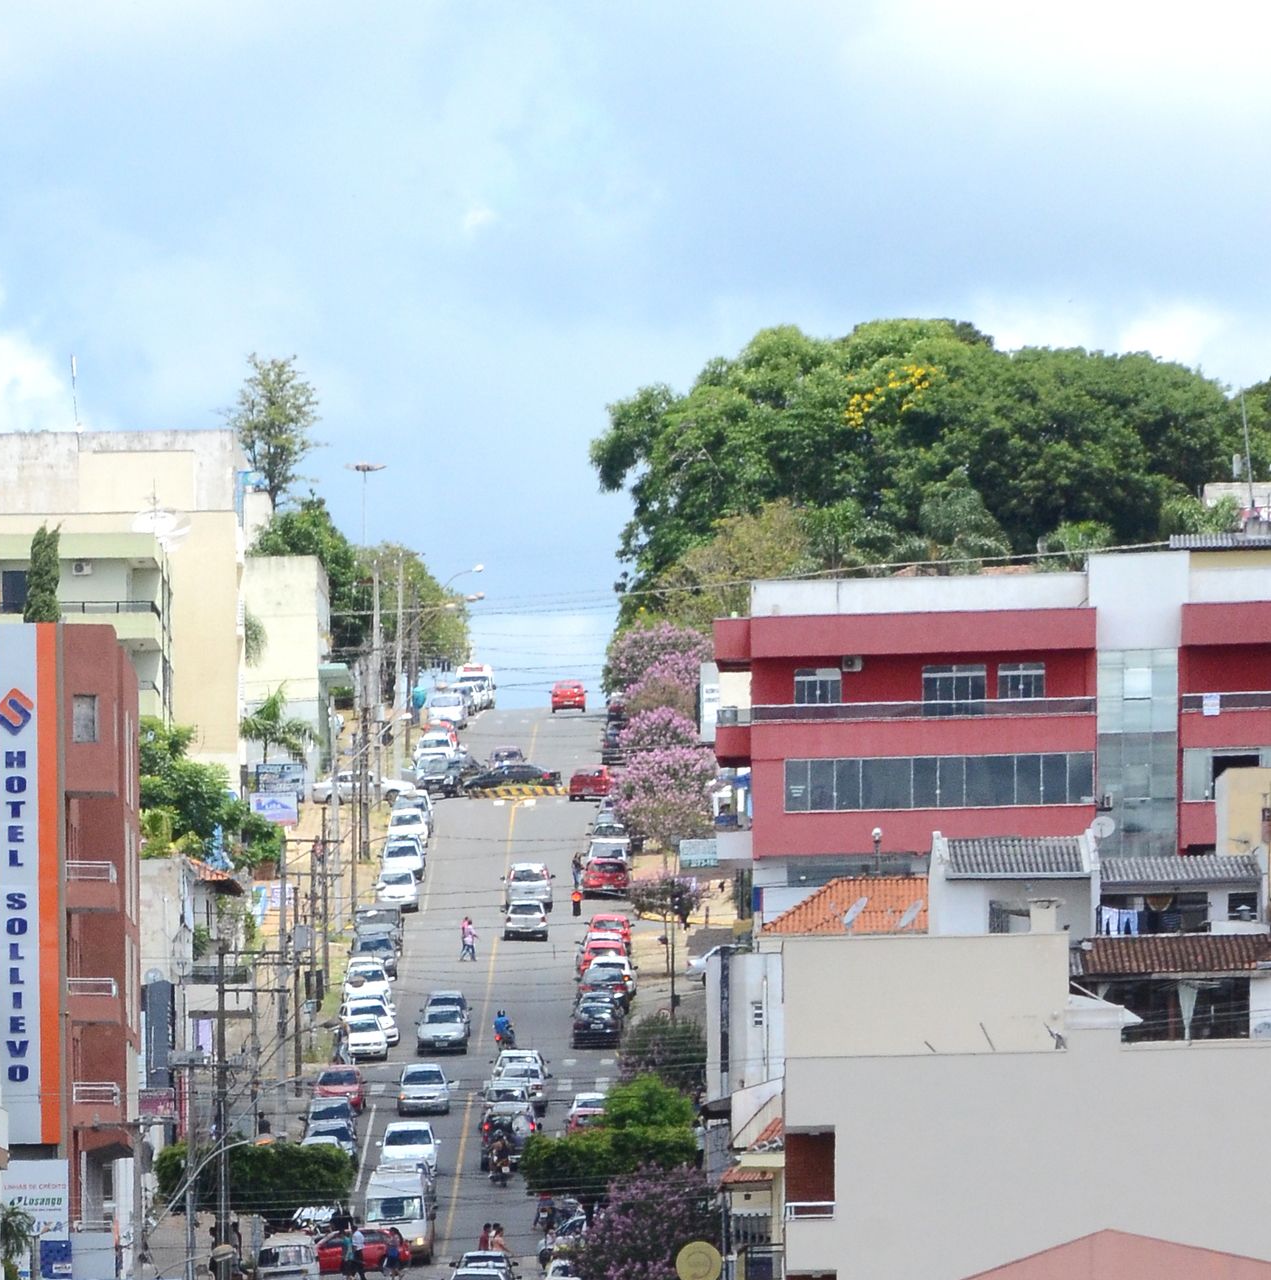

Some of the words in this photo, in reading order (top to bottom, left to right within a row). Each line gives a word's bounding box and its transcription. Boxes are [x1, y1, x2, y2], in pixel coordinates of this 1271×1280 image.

[5, 750, 27, 867] HOTEL
[6, 892, 29, 1082] SOLLIEVO
[23, 1196, 62, 1206] Losango
